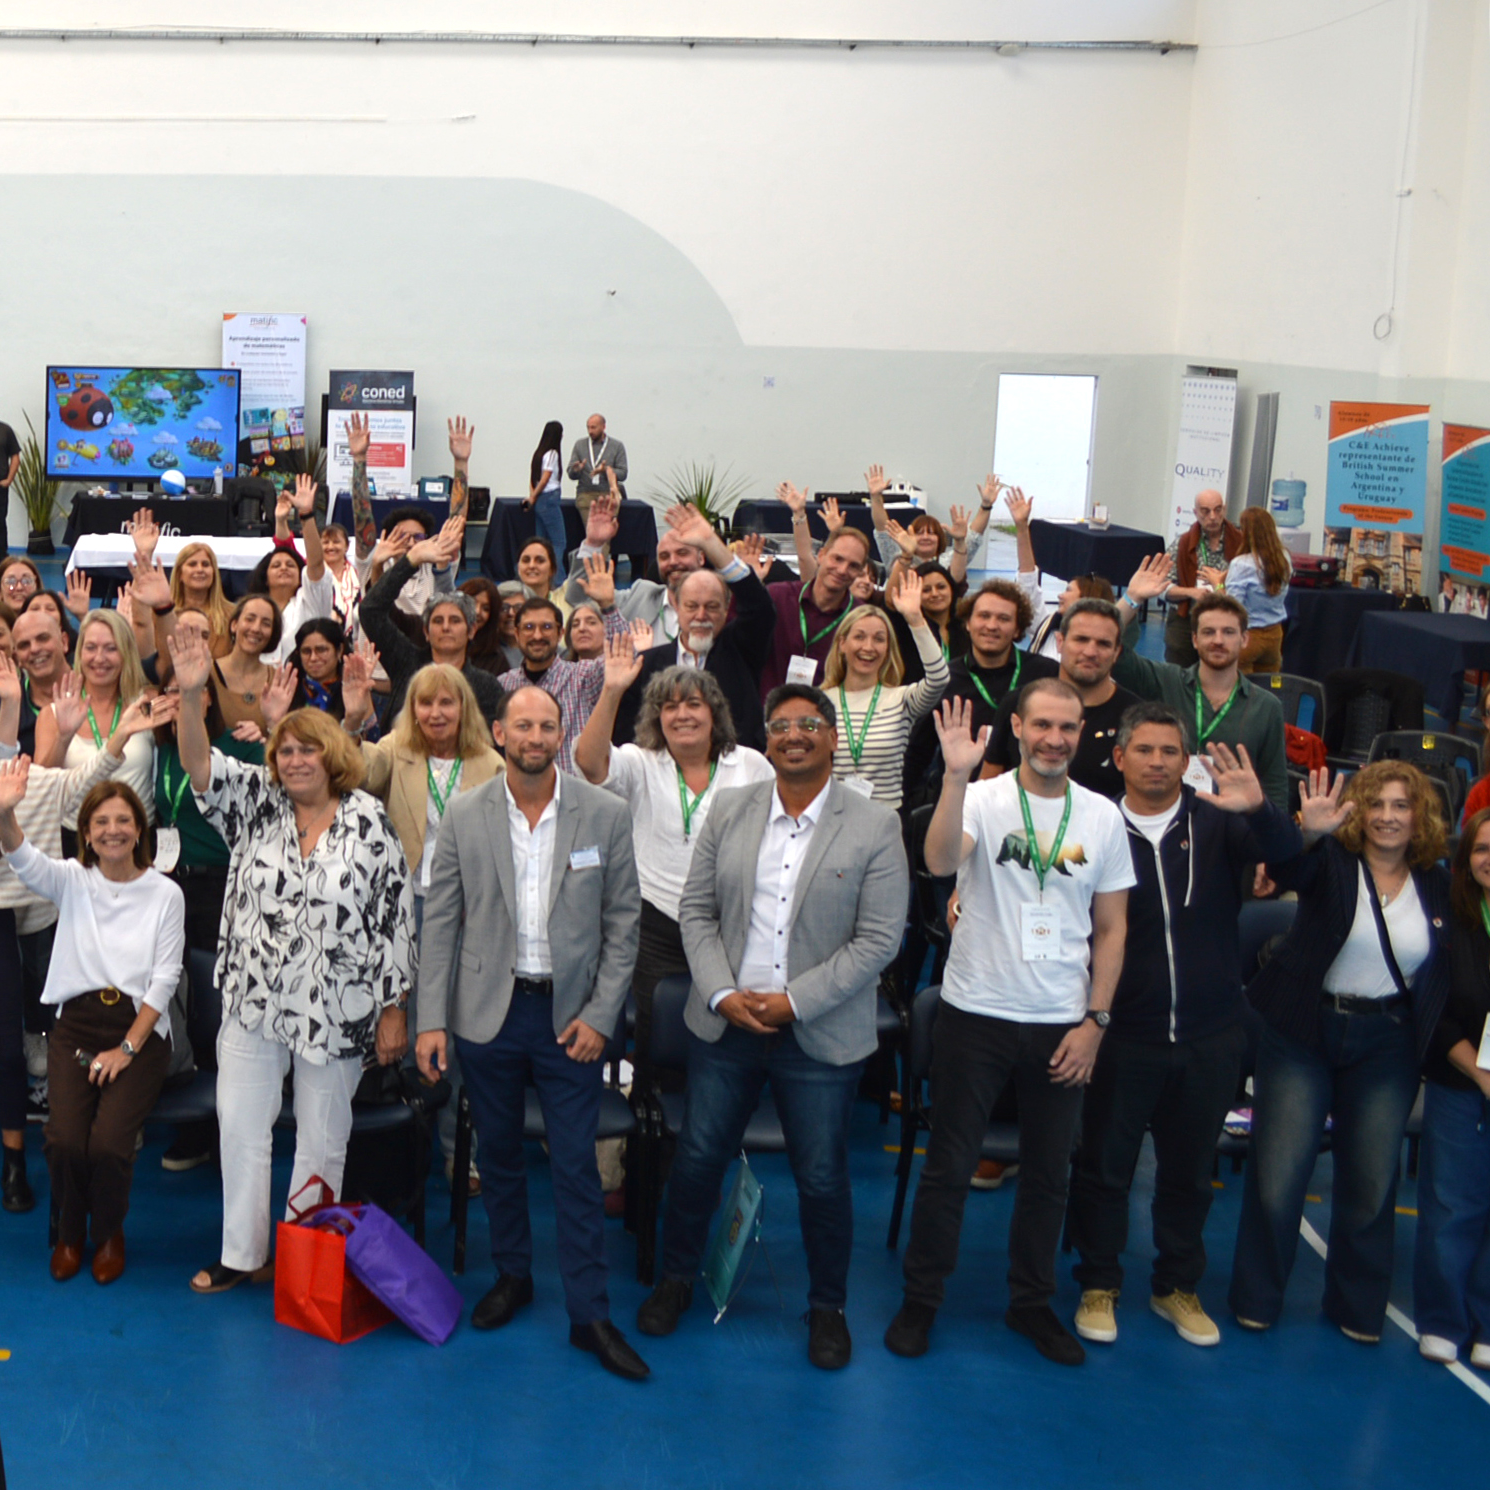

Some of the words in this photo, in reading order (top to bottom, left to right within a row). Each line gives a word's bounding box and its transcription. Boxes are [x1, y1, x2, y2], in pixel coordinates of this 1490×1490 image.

[361, 385, 405, 399] coned
[1348, 441, 1369, 450] C&E
[1372, 442, 1410, 453] Achieve
[1338, 452, 1402, 463] representante
[1404, 455, 1416, 463] de
[1175, 463, 1225, 478] QUALITY
[1342, 461, 1373, 470] British
[1377, 464, 1414, 473] Summer
[1355, 471, 1385, 481] School
[1351, 482, 1396, 493] Argentina
[1399, 487, 1404, 495] y
[1358, 492, 1397, 504] Uruguay
